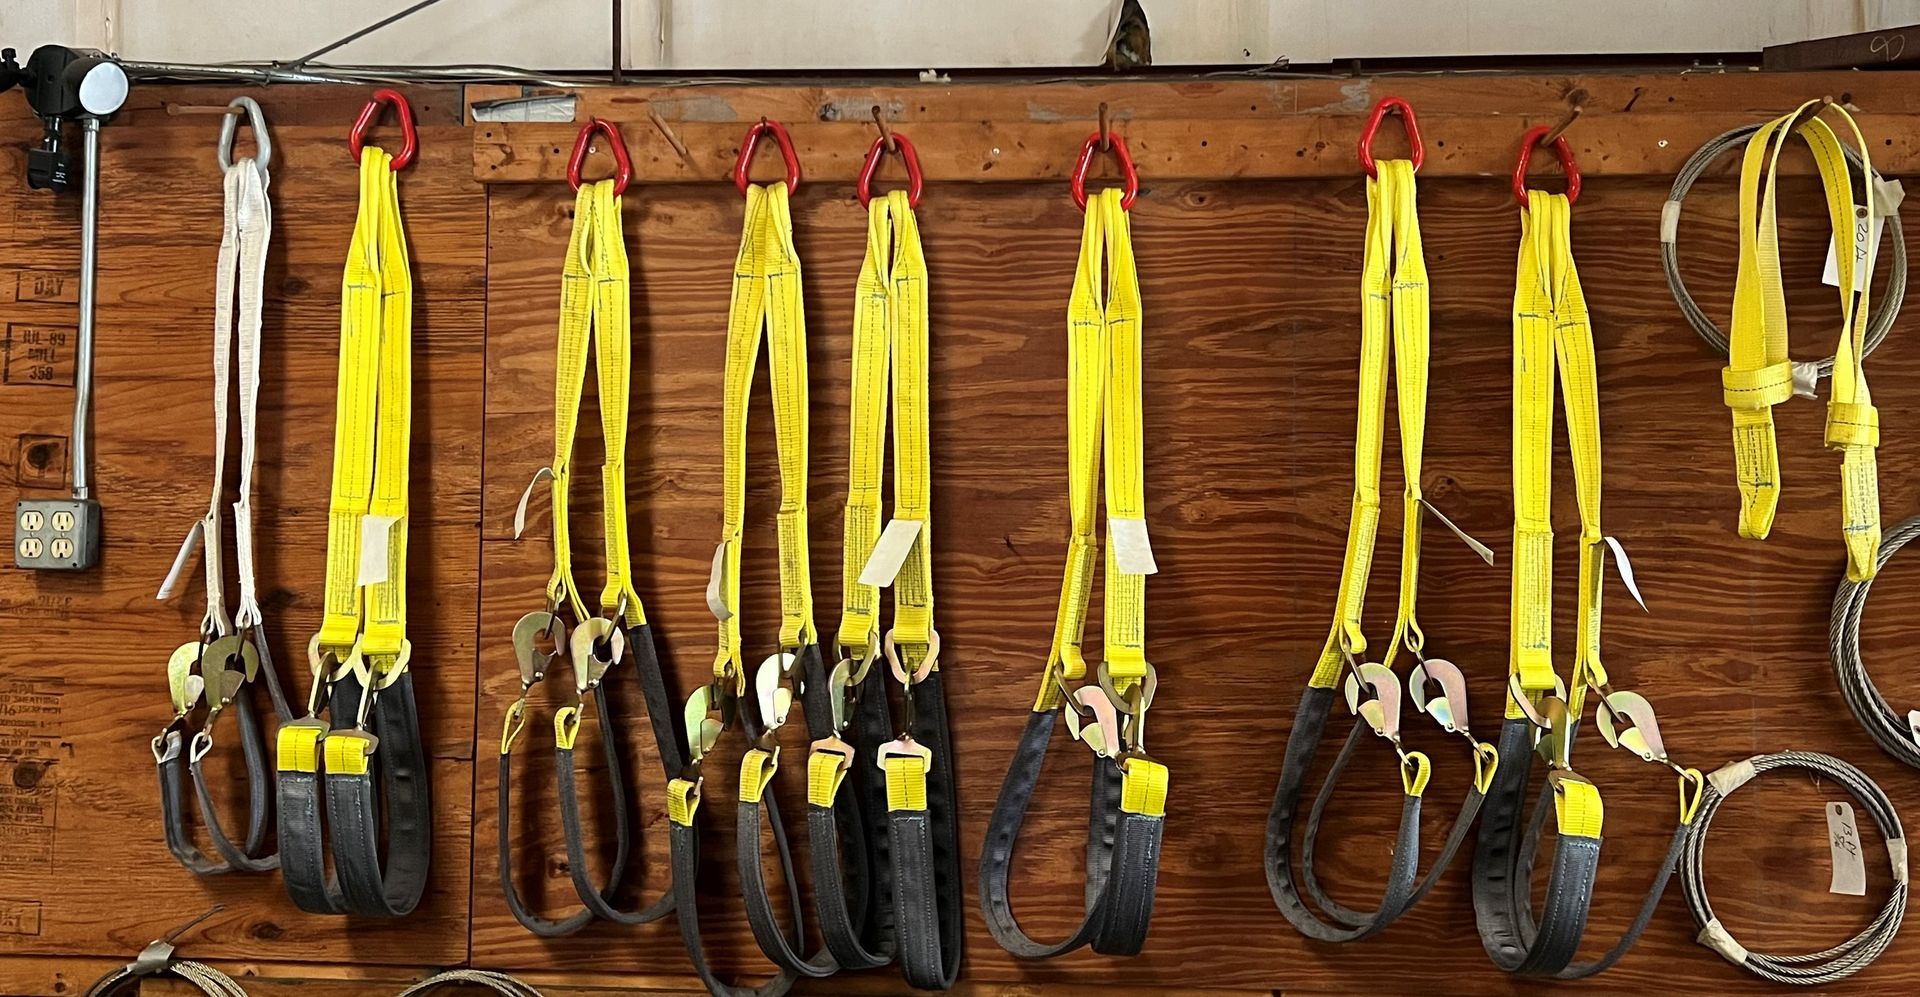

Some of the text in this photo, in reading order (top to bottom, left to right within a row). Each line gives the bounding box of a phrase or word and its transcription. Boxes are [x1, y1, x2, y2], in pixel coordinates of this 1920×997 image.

[1856, 223, 1868, 242] 20
[34, 278, 64, 296] DAY
[29, 366, 54, 380] 358
[1841, 821, 1853, 837] 13
